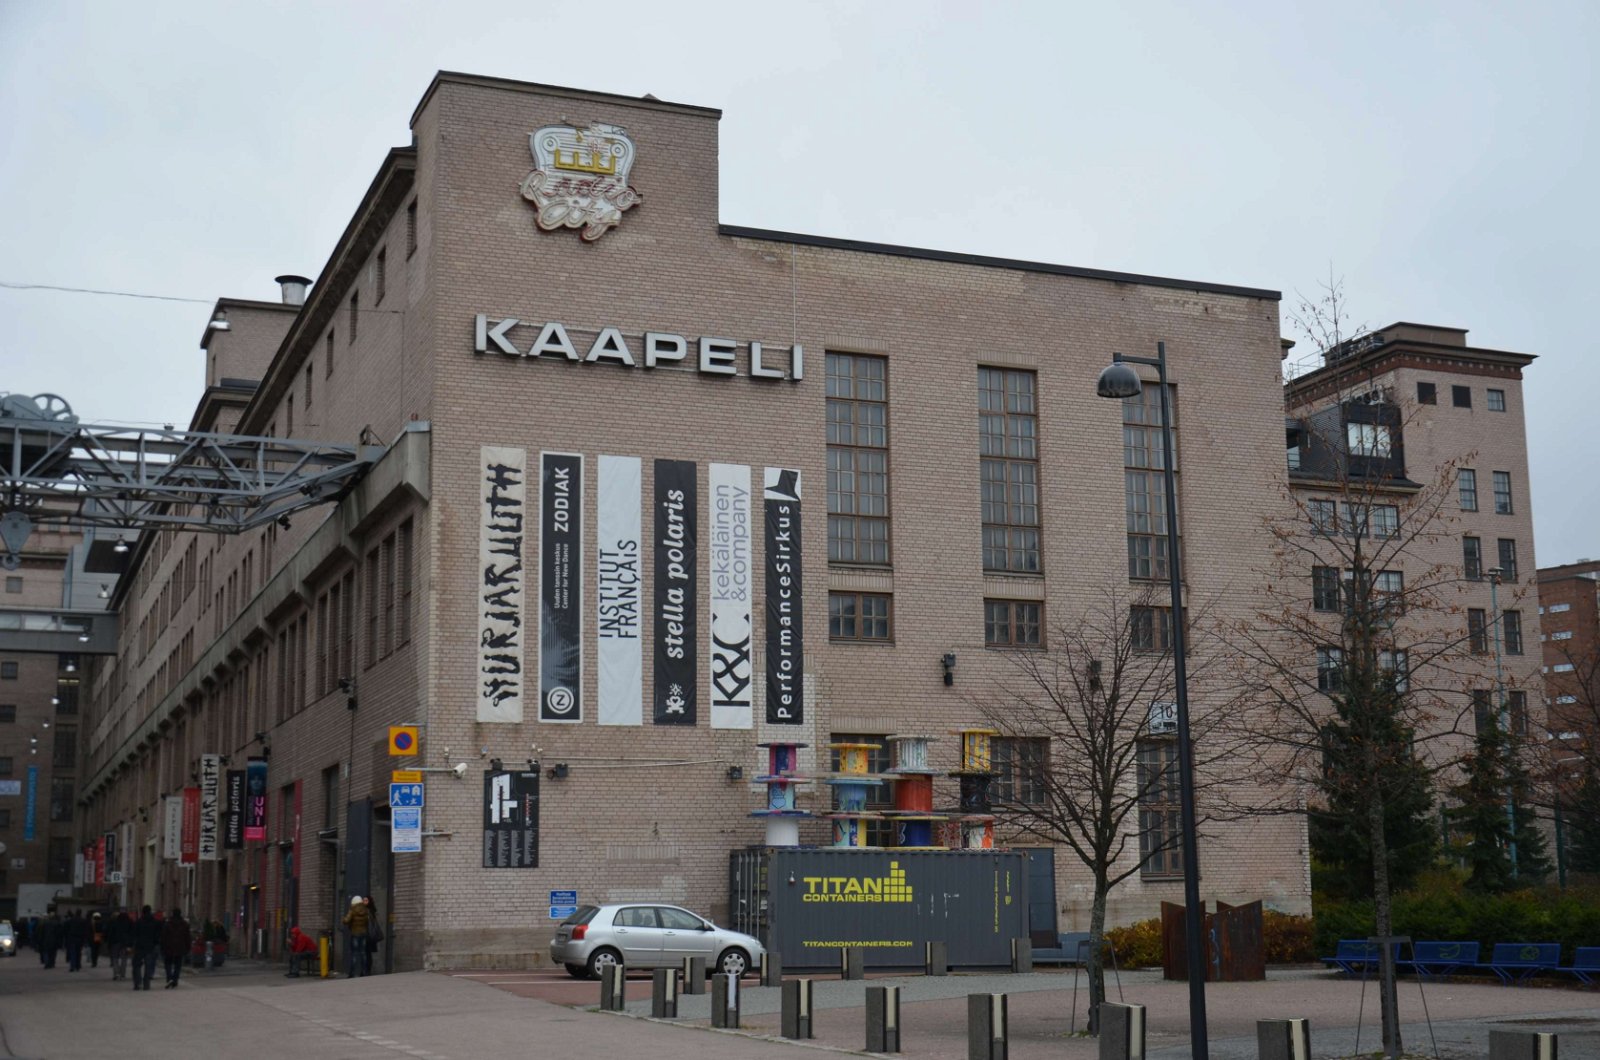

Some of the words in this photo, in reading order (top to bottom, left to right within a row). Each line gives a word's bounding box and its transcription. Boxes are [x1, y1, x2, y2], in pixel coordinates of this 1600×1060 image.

[475, 314, 803, 381] KAAPELI
[554, 467, 570, 533] ZODIAK
[663, 489, 690, 580] polaris
[712, 484, 730, 600] kekäläinen
[731, 485, 749, 602] &company
[553, 542, 561, 565] keskus
[561, 543, 569, 563] Dance
[561, 563, 569, 578] New
[481, 464, 523, 707] HURJARUUTH
[553, 565, 561, 588] tanssin
[561, 578, 569, 588] for
[599, 549, 619, 638] INSTITUT
[553, 588, 561, 609] Uuden
[561, 588, 569, 609] Center
[776, 505, 792, 719] PerformanceSirkus
[662, 588, 685, 660] stella
[712, 612, 751, 707] K&C
[230, 776, 241, 812] polaris
[228, 814, 239, 844] stella
[802, 894, 882, 902] CONTAINERS
[803, 877, 882, 894] TITAN
